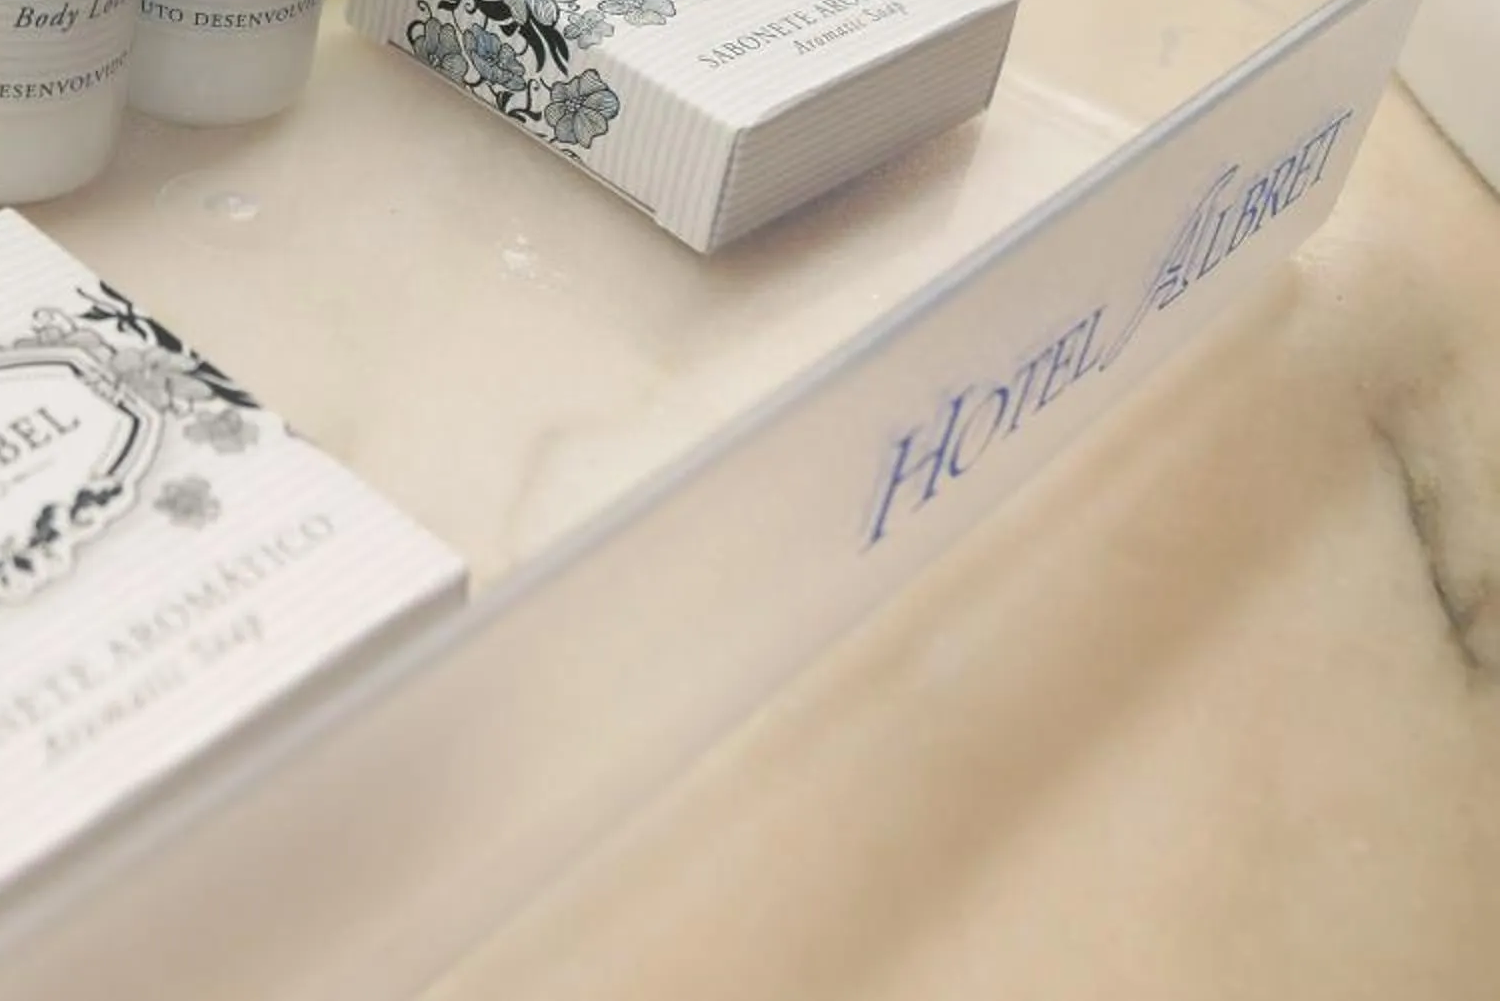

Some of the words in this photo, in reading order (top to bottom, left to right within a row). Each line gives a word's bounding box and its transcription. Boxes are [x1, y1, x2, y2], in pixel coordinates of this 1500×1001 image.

[13, 1, 80, 33] Body
[699, 10, 817, 70] SABONETE
[792, 17, 868, 55] Aromatic
[866, 0, 909, 23] Soap
[858, 304, 1108, 555] HOTEL
[1099, 109, 1353, 372] ALBRET
